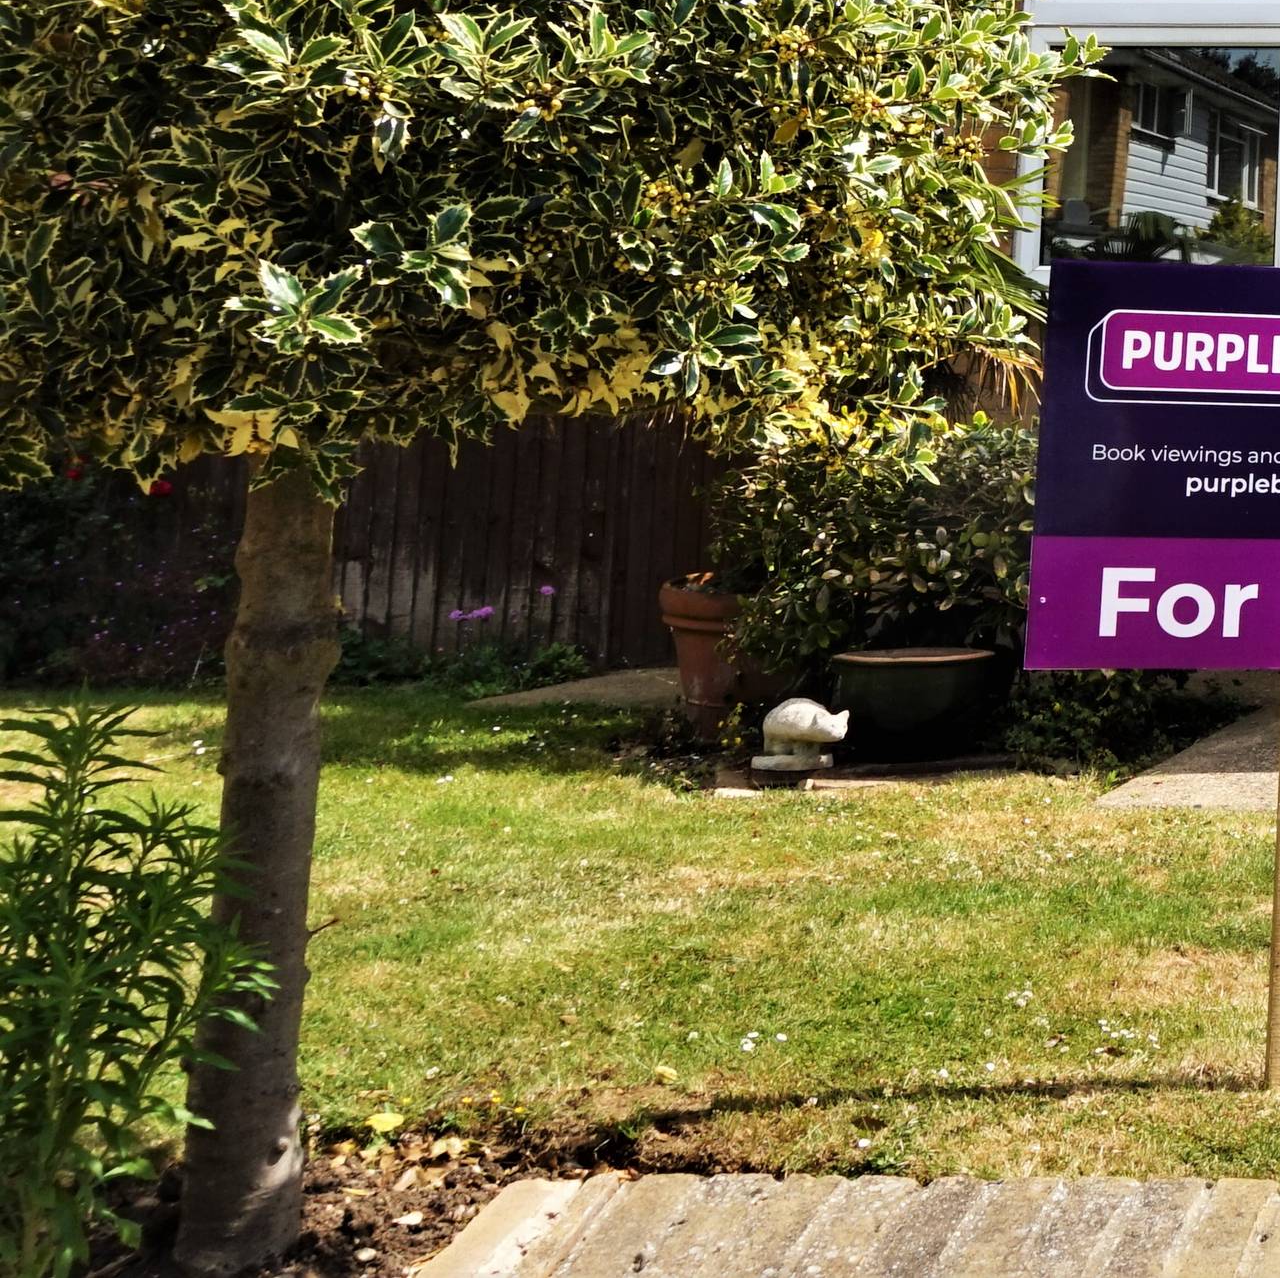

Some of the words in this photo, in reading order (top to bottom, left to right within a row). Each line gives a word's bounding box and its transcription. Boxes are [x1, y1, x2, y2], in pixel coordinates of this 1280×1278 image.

[1092, 443, 1146, 462] Book
[1151, 444, 1243, 467] viewings
[1098, 567, 1259, 638] For
